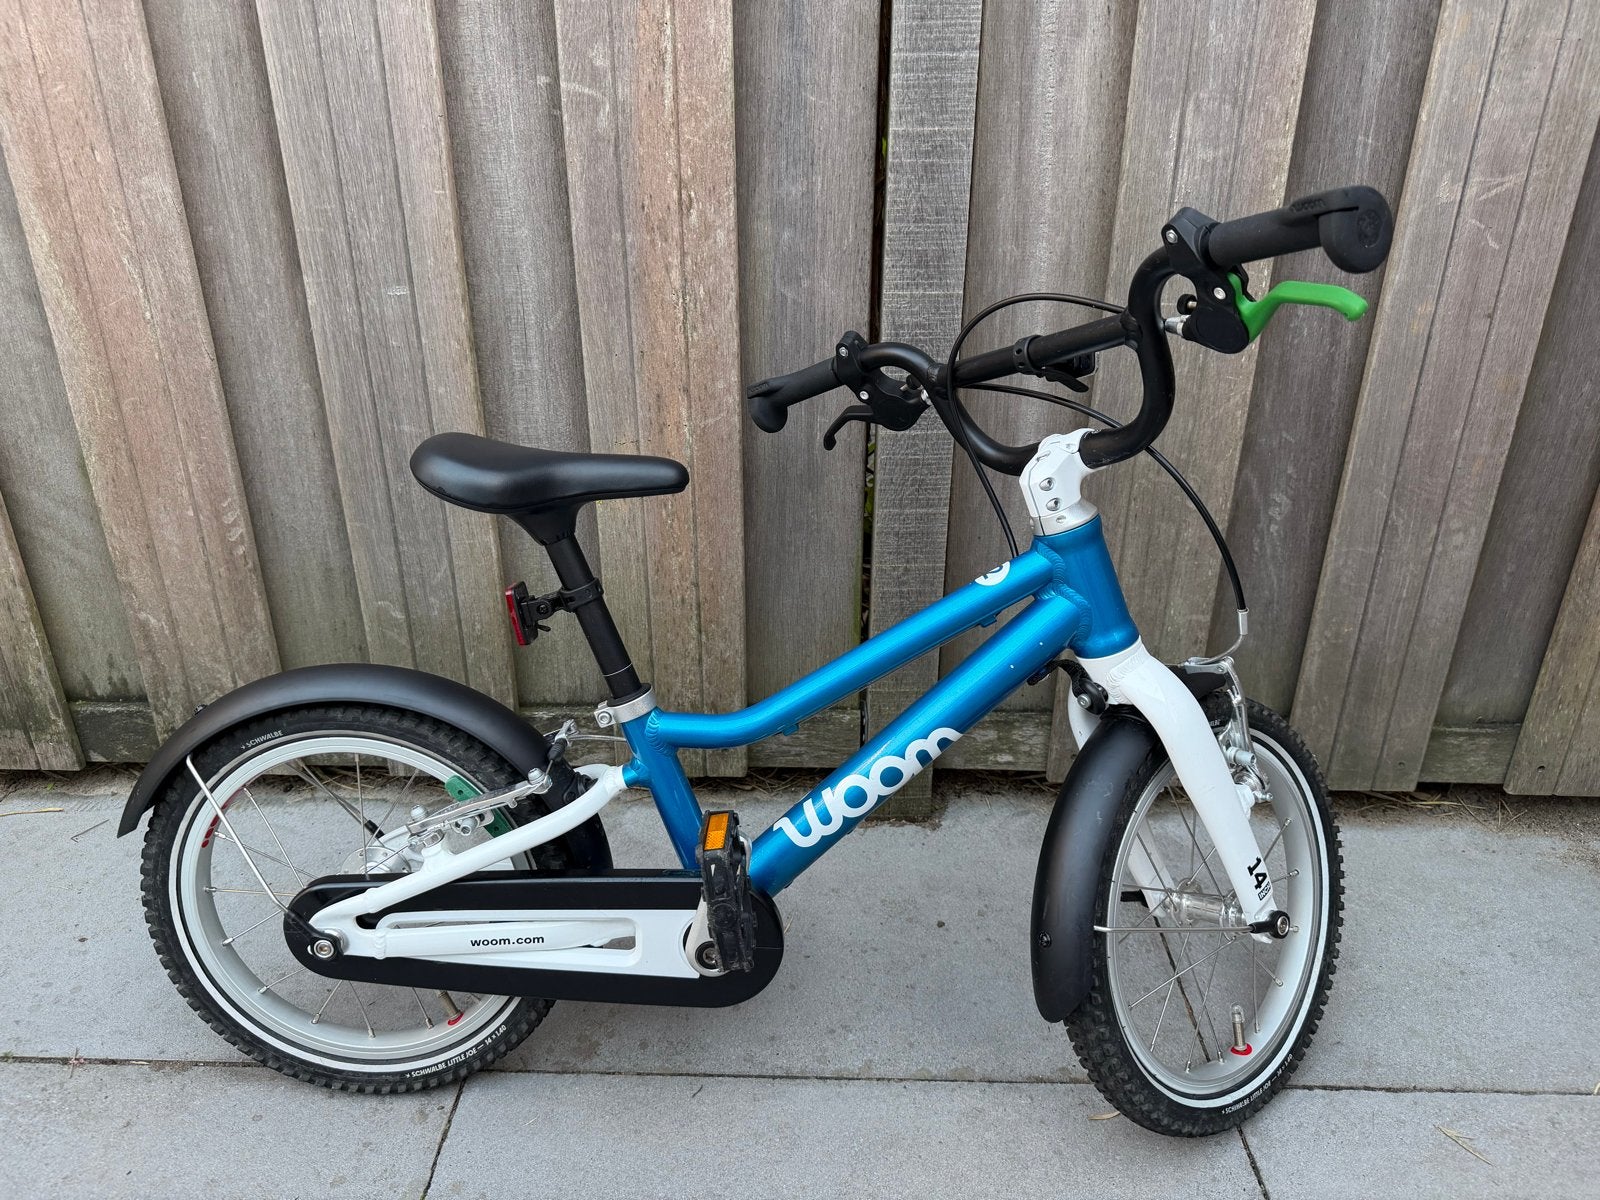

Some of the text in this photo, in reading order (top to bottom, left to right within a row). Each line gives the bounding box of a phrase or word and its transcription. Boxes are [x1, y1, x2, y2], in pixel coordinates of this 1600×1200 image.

[246, 730, 283, 747] SCHWALBE
[773, 727, 964, 848] woom
[1247, 856, 1267, 890] 14
[470, 936, 545, 947] woom.com
[411, 1063, 447, 1078] SCHWALBE
[447, 1053, 466, 1067] LITTLE
[465, 1048, 477, 1058] JOE
[484, 1037, 492, 1046] 14
[495, 1024, 507, 1037] 1.40
